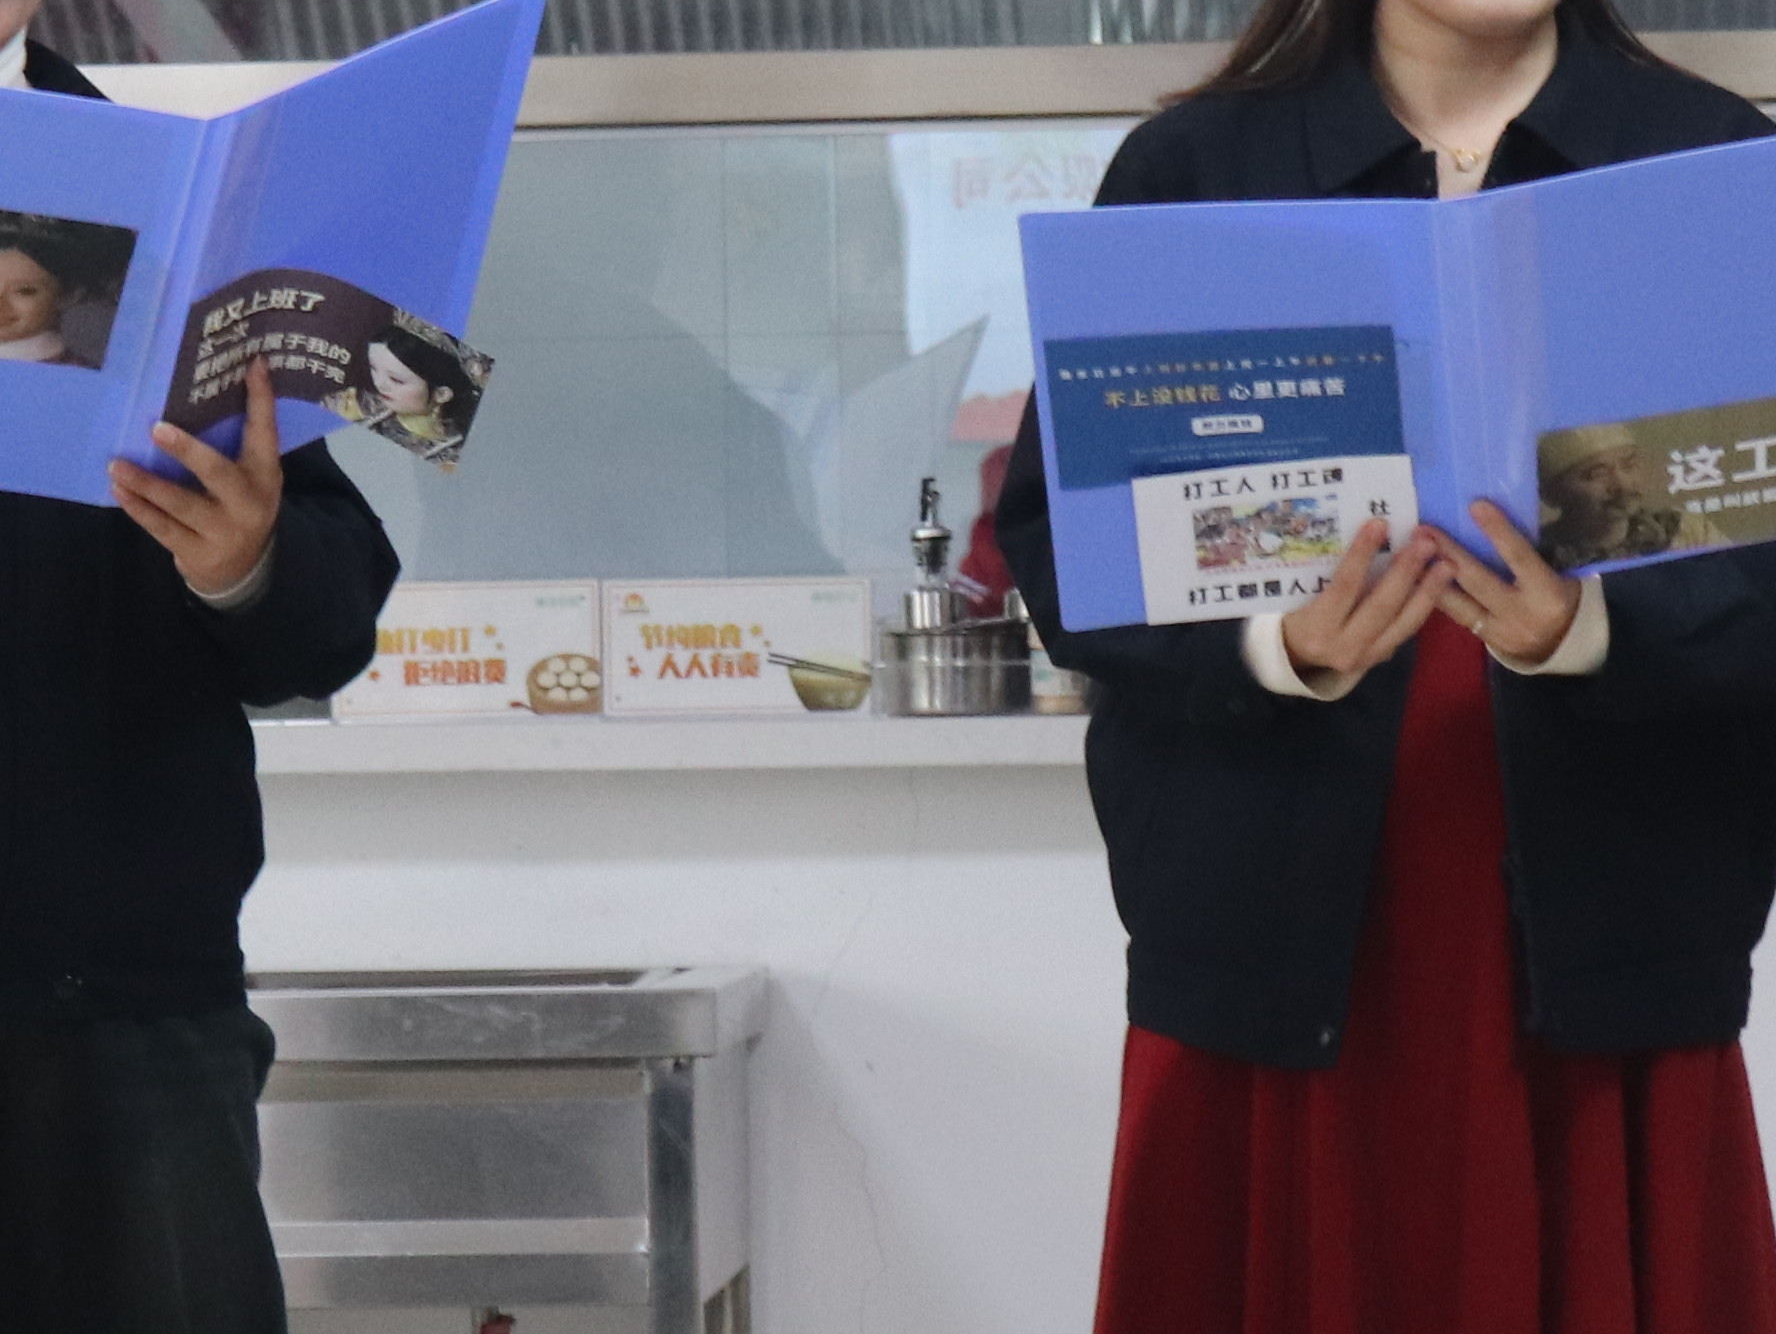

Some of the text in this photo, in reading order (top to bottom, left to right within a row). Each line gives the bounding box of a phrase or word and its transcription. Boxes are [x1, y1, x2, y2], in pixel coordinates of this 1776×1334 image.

[202, 287, 326, 339] 我又上班了
[1183, 467, 1344, 502] 打工人 打工魂
[404, 657, 507, 686] 拒绝浪费
